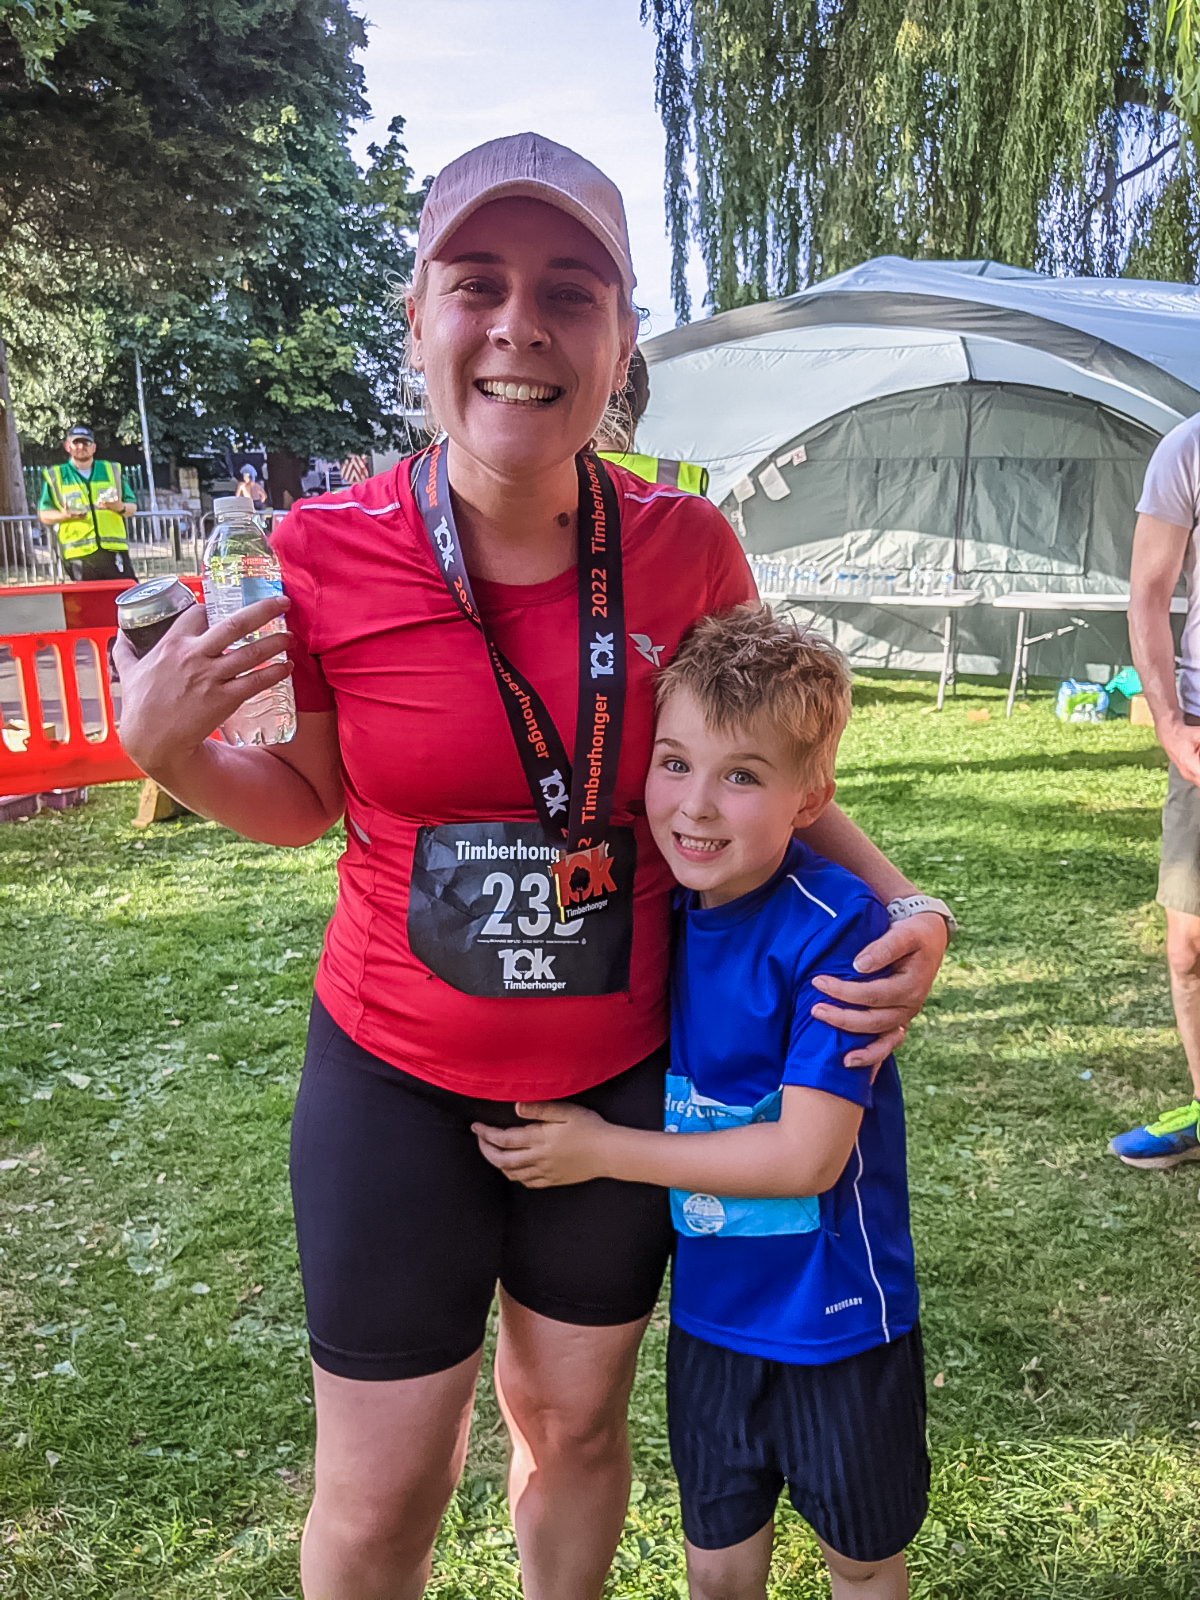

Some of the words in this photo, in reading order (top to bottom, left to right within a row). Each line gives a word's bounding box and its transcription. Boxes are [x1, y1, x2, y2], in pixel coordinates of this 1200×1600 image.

[591, 568, 607, 618] 2022
[581, 693, 610, 825] Timberhonger
[455, 838, 560, 864] Timberhong
[551, 847, 618, 907] 10k
[566, 899, 608, 918] Timberhonger
[497, 947, 557, 980] 10k
[503, 980, 567, 991] Timberhonger
